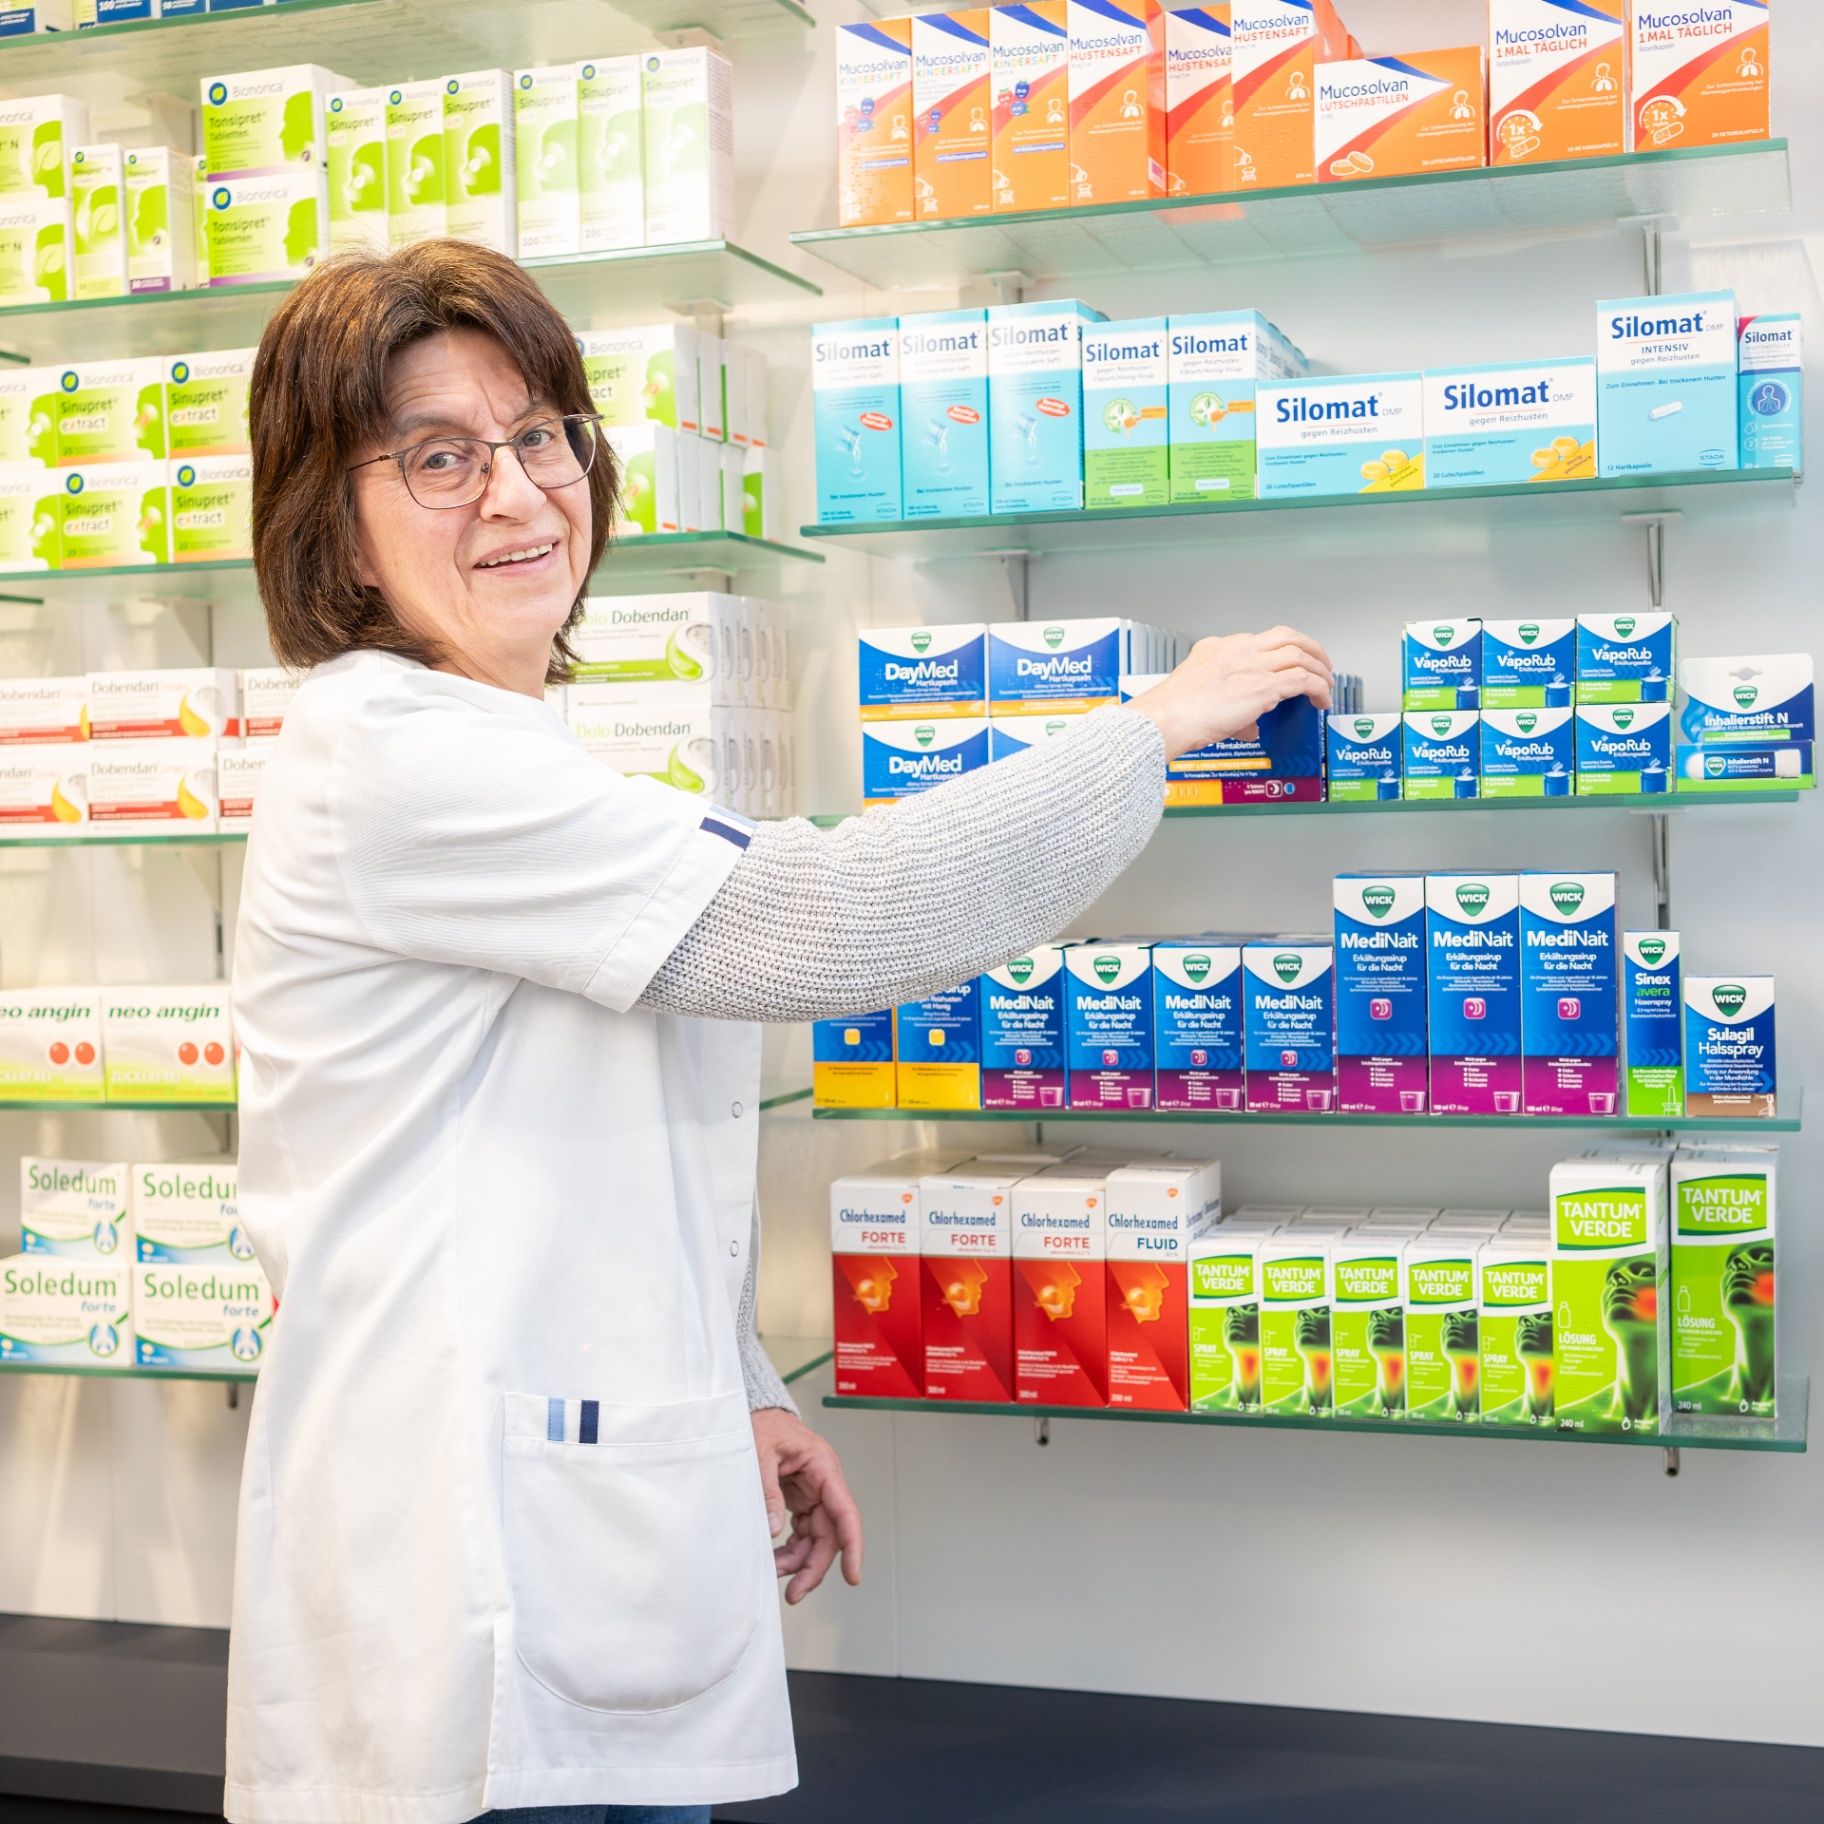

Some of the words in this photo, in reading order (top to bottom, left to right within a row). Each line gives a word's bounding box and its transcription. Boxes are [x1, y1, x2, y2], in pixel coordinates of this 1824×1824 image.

[1234, 13, 1310, 32] Mucosolvan
[1639, 7, 1733, 30] Mucosolvan
[1234, 26, 1309, 43] HUSTENSAFT
[1496, 23, 1587, 45] Mucosolvan
[1639, 33, 1646, 43] 1
[1648, 28, 1674, 42] MAL
[1677, 22, 1733, 39] TÄGLICH
[993, 40, 1065, 59] Mucosolvan
[1070, 32, 1143, 51] Mucosolvan
[1497, 48, 1503, 58] 1
[1505, 43, 1531, 57] MAL
[1534, 36, 1588, 54] TÄGLICH
[916, 51, 987, 68] Mucosolvan
[1071, 45, 1142, 61] HUSTENSAFT
[839, 58, 909, 76] Mucosolvan
[994, 54, 1058, 70] KINDERSAFT
[840, 72, 902, 86] KINDERSAFT
[917, 64, 980, 78] KINDERSAFT
[581, 84, 629, 102] Sinupret
[1320, 77, 1409, 101] Mucosolvan
[446, 98, 491, 116] Sinupret
[519, 93, 567, 110] Sinupret
[1320, 93, 1409, 112] LUTSCHPASTILLEN
[209, 112, 262, 130] Tonsipret
[329, 116, 374, 132] Sinupret
[389, 108, 434, 125] Sinupret
[212, 217, 265, 234] Tonsipret
[1611, 312, 1703, 339] Silomat
[1705, 323, 1724, 332] DMP
[903, 332, 978, 355] Silomat
[991, 323, 1068, 348] Silomat
[1744, 329, 1792, 344] Silomat
[590, 339, 644, 355] Bionorica
[816, 340, 890, 362] Silomat
[1086, 341, 1160, 363] Silomat
[1172, 333, 1248, 356] Silomat
[1641, 343, 1689, 354] INTENSIV
[1630, 354, 1655, 366] gegen
[1657, 352, 1700, 363] Reizhusten
[1606, 382, 1620, 390] Zum
[1621, 379, 1656, 389] Einnehmen
[1669, 376, 1702, 385] trockenem
[1704, 374, 1726, 382] Husten
[171, 389, 225, 407] Sinupret
[1444, 381, 1550, 411] Silomat
[1553, 393, 1574, 402] DMP
[61, 399, 113, 415] Sinupret
[1276, 395, 1379, 423] Silomat
[1382, 407, 1403, 416] DMP
[171, 408, 217, 425] extract
[1469, 416, 1497, 426] gegen
[1499, 411, 1548, 423] Reizhusten
[61, 417, 106, 433] extract
[1301, 428, 1328, 439] gegen
[1330, 425, 1377, 435] Reizhusten
[65, 501, 117, 518] Sinupret
[176, 492, 230, 511] Sinupret
[65, 518, 110, 535] extract
[177, 511, 222, 528] extract
[1519, 628, 1539, 637] WICK
[1615, 622, 1634, 631] WICK
[1414, 655, 1472, 672] VapoRub
[1497, 653, 1556, 671] VapoRub
[1592, 647, 1652, 666] VapoRub
[885, 659, 958, 685] DayMed
[1017, 654, 1092, 681] DayMed
[1048, 673, 1092, 684] Hartkapseln
[92, 680, 159, 694] Dobendan
[1734, 691, 1757, 701] WICK
[1354, 723, 1374, 732] WICK
[1432, 720, 1451, 729] WICK
[1705, 713, 1776, 728] Inhalierstift
[1777, 713, 1789, 724] N
[614, 721, 691, 737] Dobendan
[1216, 740, 1261, 751] Filmtabletten
[1411, 745, 1470, 760] VapoRub
[1495, 742, 1554, 757] VapoRub
[1590, 738, 1651, 753] VapoRub
[1335, 746, 1393, 762] VapoRub
[91, 763, 158, 776] Dobendan
[889, 753, 963, 779] DayMed
[1364, 895, 1393, 906] WICK
[1458, 893, 1488, 904] WICK
[1552, 891, 1582, 903] WICK
[1340, 931, 1419, 949] MediNait
[1433, 930, 1514, 948] MediNait
[1527, 929, 1609, 947] MediNait
[1445, 952, 1502, 964] Erkältungssirup
[1539, 951, 1597, 964] Erkältungssirup
[1639, 945, 1665, 955] WICK
[1352, 953, 1408, 965] Erkältungssirup
[1007, 963, 1034, 974] WICK
[1094, 963, 1120, 974] WICK
[1184, 962, 1210, 973] WICK
[1274, 962, 1301, 973] WICK
[1635, 973, 1671, 986] Sinex
[1636, 986, 1670, 997] avera
[1714, 993, 1745, 1004] WICK
[990, 995, 1055, 1011] MediNait
[1076, 995, 1142, 1011] MediNait
[1165, 995, 1232, 1011] MediNait
[1255, 995, 1323, 1011] MediNait
[1634, 998, 1673, 1008] Nasenspray
[28, 1002, 92, 1023] angin
[108, 1006, 152, 1019] neo
[156, 1002, 221, 1023] angin
[998, 1011, 1049, 1024] Erkältungssirup
[1085, 1011, 1136, 1024] Erkältungssirup
[1173, 1011, 1226, 1024] Erkältungssirup
[1263, 1011, 1317, 1024] Erkältungssirup
[1707, 1027, 1755, 1045] Sulagil
[1698, 1042, 1764, 1060] Halsspray
[111, 1069, 182, 1085] ZUCKERFREI
[28, 1164, 117, 1196] Soledum
[143, 1172, 237, 1200] Soledu
[88, 1198, 116, 1211] forte
[1682, 1187, 1762, 1207] TANTUM
[840, 1208, 906, 1224] Chlorhexamed
[1560, 1201, 1641, 1220] TANTUM
[1690, 1206, 1754, 1224] VERDE
[929, 1211, 996, 1227] Chlorhexamed
[1021, 1213, 1090, 1229] Chlorhexamed
[1108, 1213, 1178, 1230] Chlorhexamed
[861, 1230, 906, 1244] FORTE
[1569, 1220, 1633, 1238] VERDE
[951, 1233, 996, 1247] FORTE
[1044, 1236, 1090, 1249] FORTE
[1137, 1238, 1178, 1250] FLUID
[1195, 1263, 1250, 1278] TANTUM
[1265, 1266, 1322, 1280] TANTUM
[1337, 1266, 1395, 1281] TANTUM
[1411, 1268, 1470, 1283] TANTUM
[1485, 1270, 1544, 1285] TANTUM
[4, 1268, 117, 1297] Soledum
[143, 1272, 260, 1302] Soledum
[1201, 1277, 1245, 1291] VERDE
[1271, 1280, 1316, 1294] VERDE
[1343, 1280, 1389, 1294] VERDE
[1418, 1282, 1464, 1297] VERDE
[1492, 1285, 1538, 1299] VERDE
[81, 1300, 117, 1314] forte
[222, 1303, 260, 1318] forte
[1677, 1315, 1716, 1329] LÖSUNG
[1558, 1332, 1597, 1346] LÖSUNG
[1193, 1343, 1217, 1354] SPRAY
[1264, 1347, 1288, 1358] SPRAY
[1336, 1348, 1360, 1359] SPRAY
[1409, 1350, 1434, 1361] SPRAY
[1482, 1353, 1508, 1364] SPRAY
[1560, 1418, 1575, 1428] 240
[1575, 1418, 1585, 1428] ml
